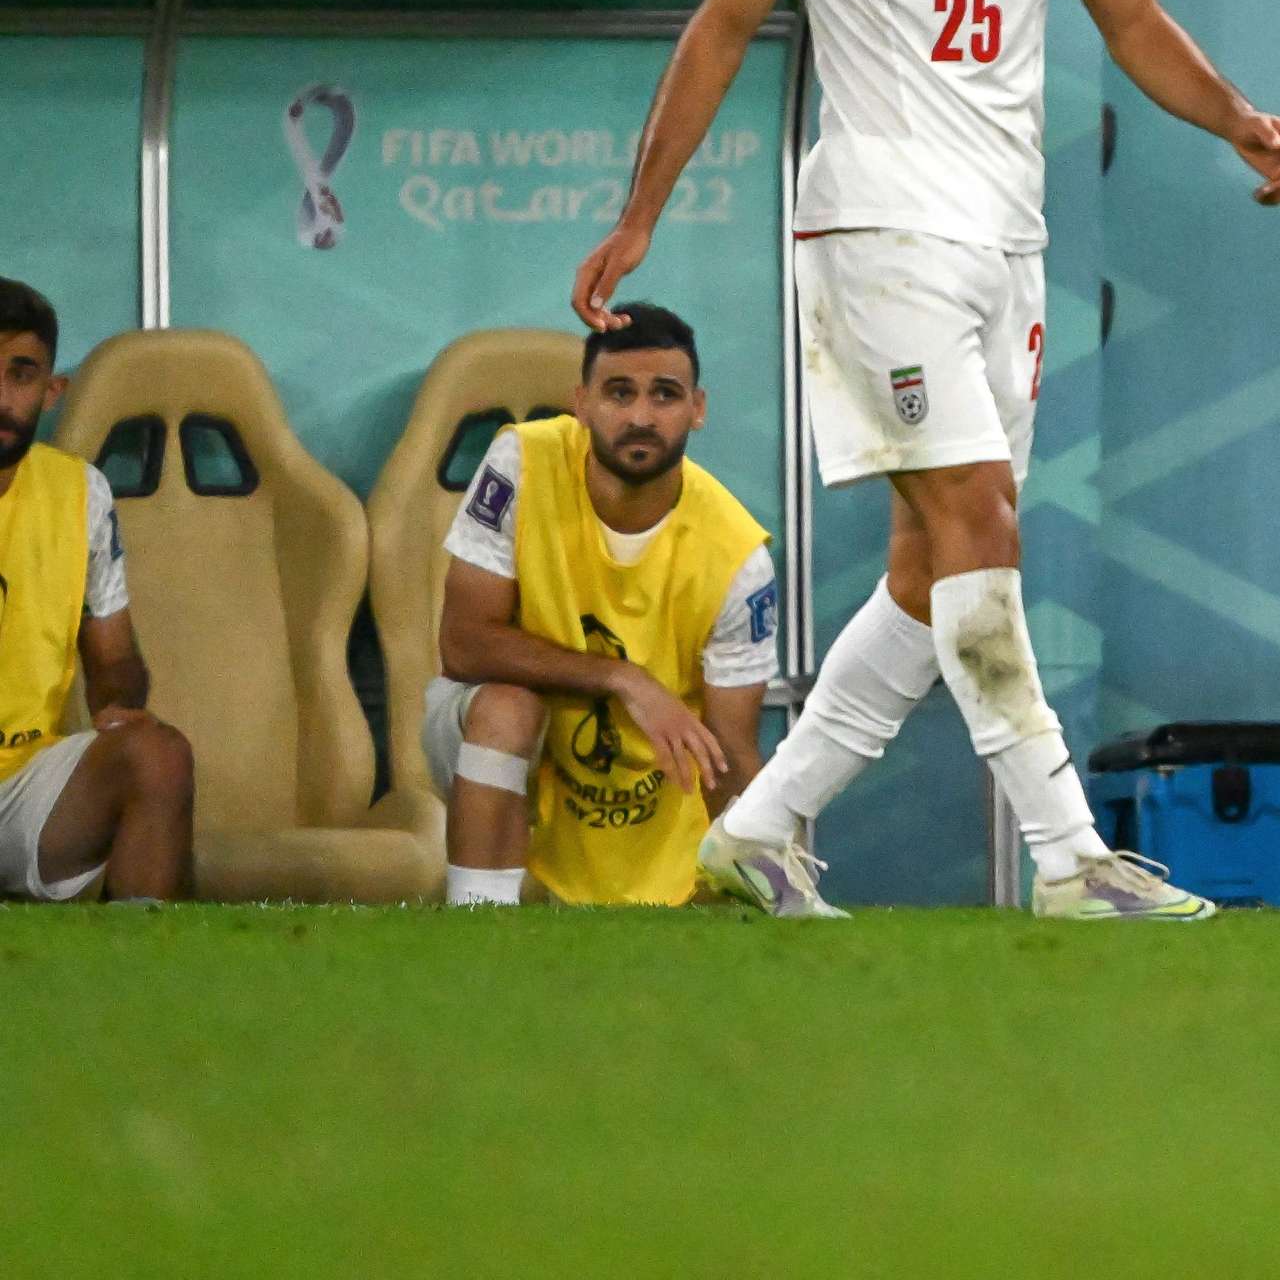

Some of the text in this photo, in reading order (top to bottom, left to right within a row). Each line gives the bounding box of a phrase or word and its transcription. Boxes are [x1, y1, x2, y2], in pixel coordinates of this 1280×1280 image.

[382, 128, 761, 167] FIFA WORL UP
